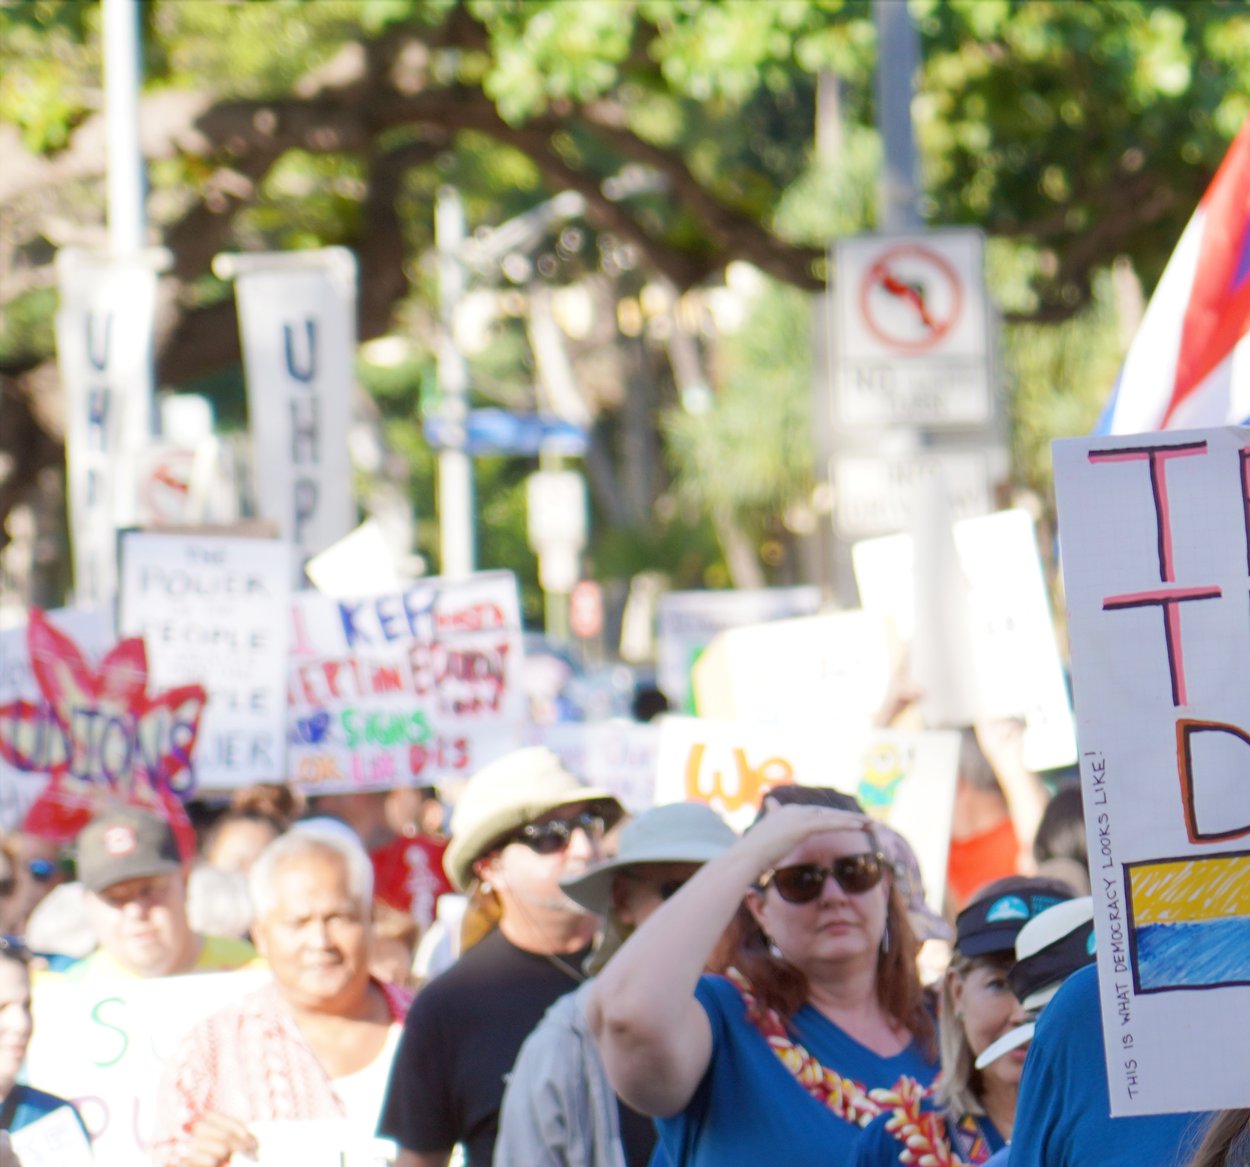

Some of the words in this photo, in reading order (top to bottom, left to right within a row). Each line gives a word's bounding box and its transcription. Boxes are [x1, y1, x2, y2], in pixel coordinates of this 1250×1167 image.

[1084, 750, 1107, 806] LIKE!
[1097, 812, 1114, 869] LOOKS
[1103, 878, 1128, 974] DEMOCRACY
[1115, 982, 1134, 1026] WHAT
[1122, 1033, 1134, 1050] IS
[1125, 1058, 1139, 1100] THIS
